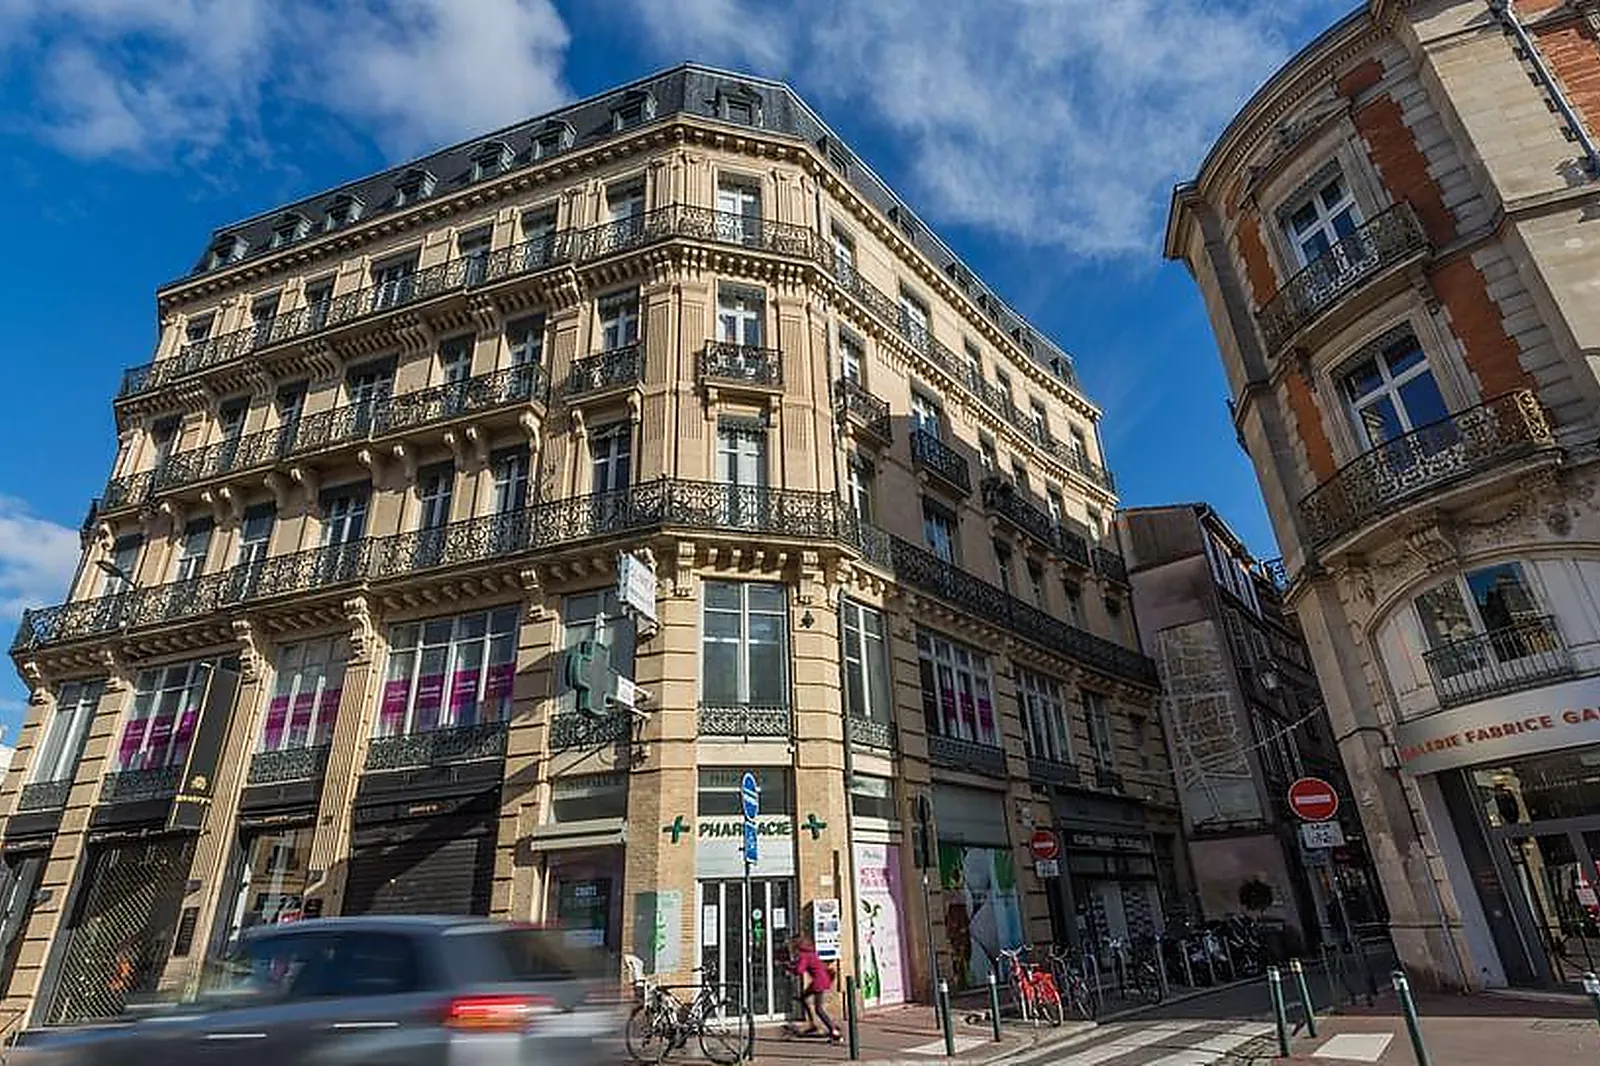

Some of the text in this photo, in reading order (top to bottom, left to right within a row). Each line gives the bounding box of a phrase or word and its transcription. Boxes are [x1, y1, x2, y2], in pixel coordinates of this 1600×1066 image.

[1464, 715, 1555, 743] FABRICE
[1562, 706, 1600, 724] GA
[698, 821, 792, 837] PHARACIE
